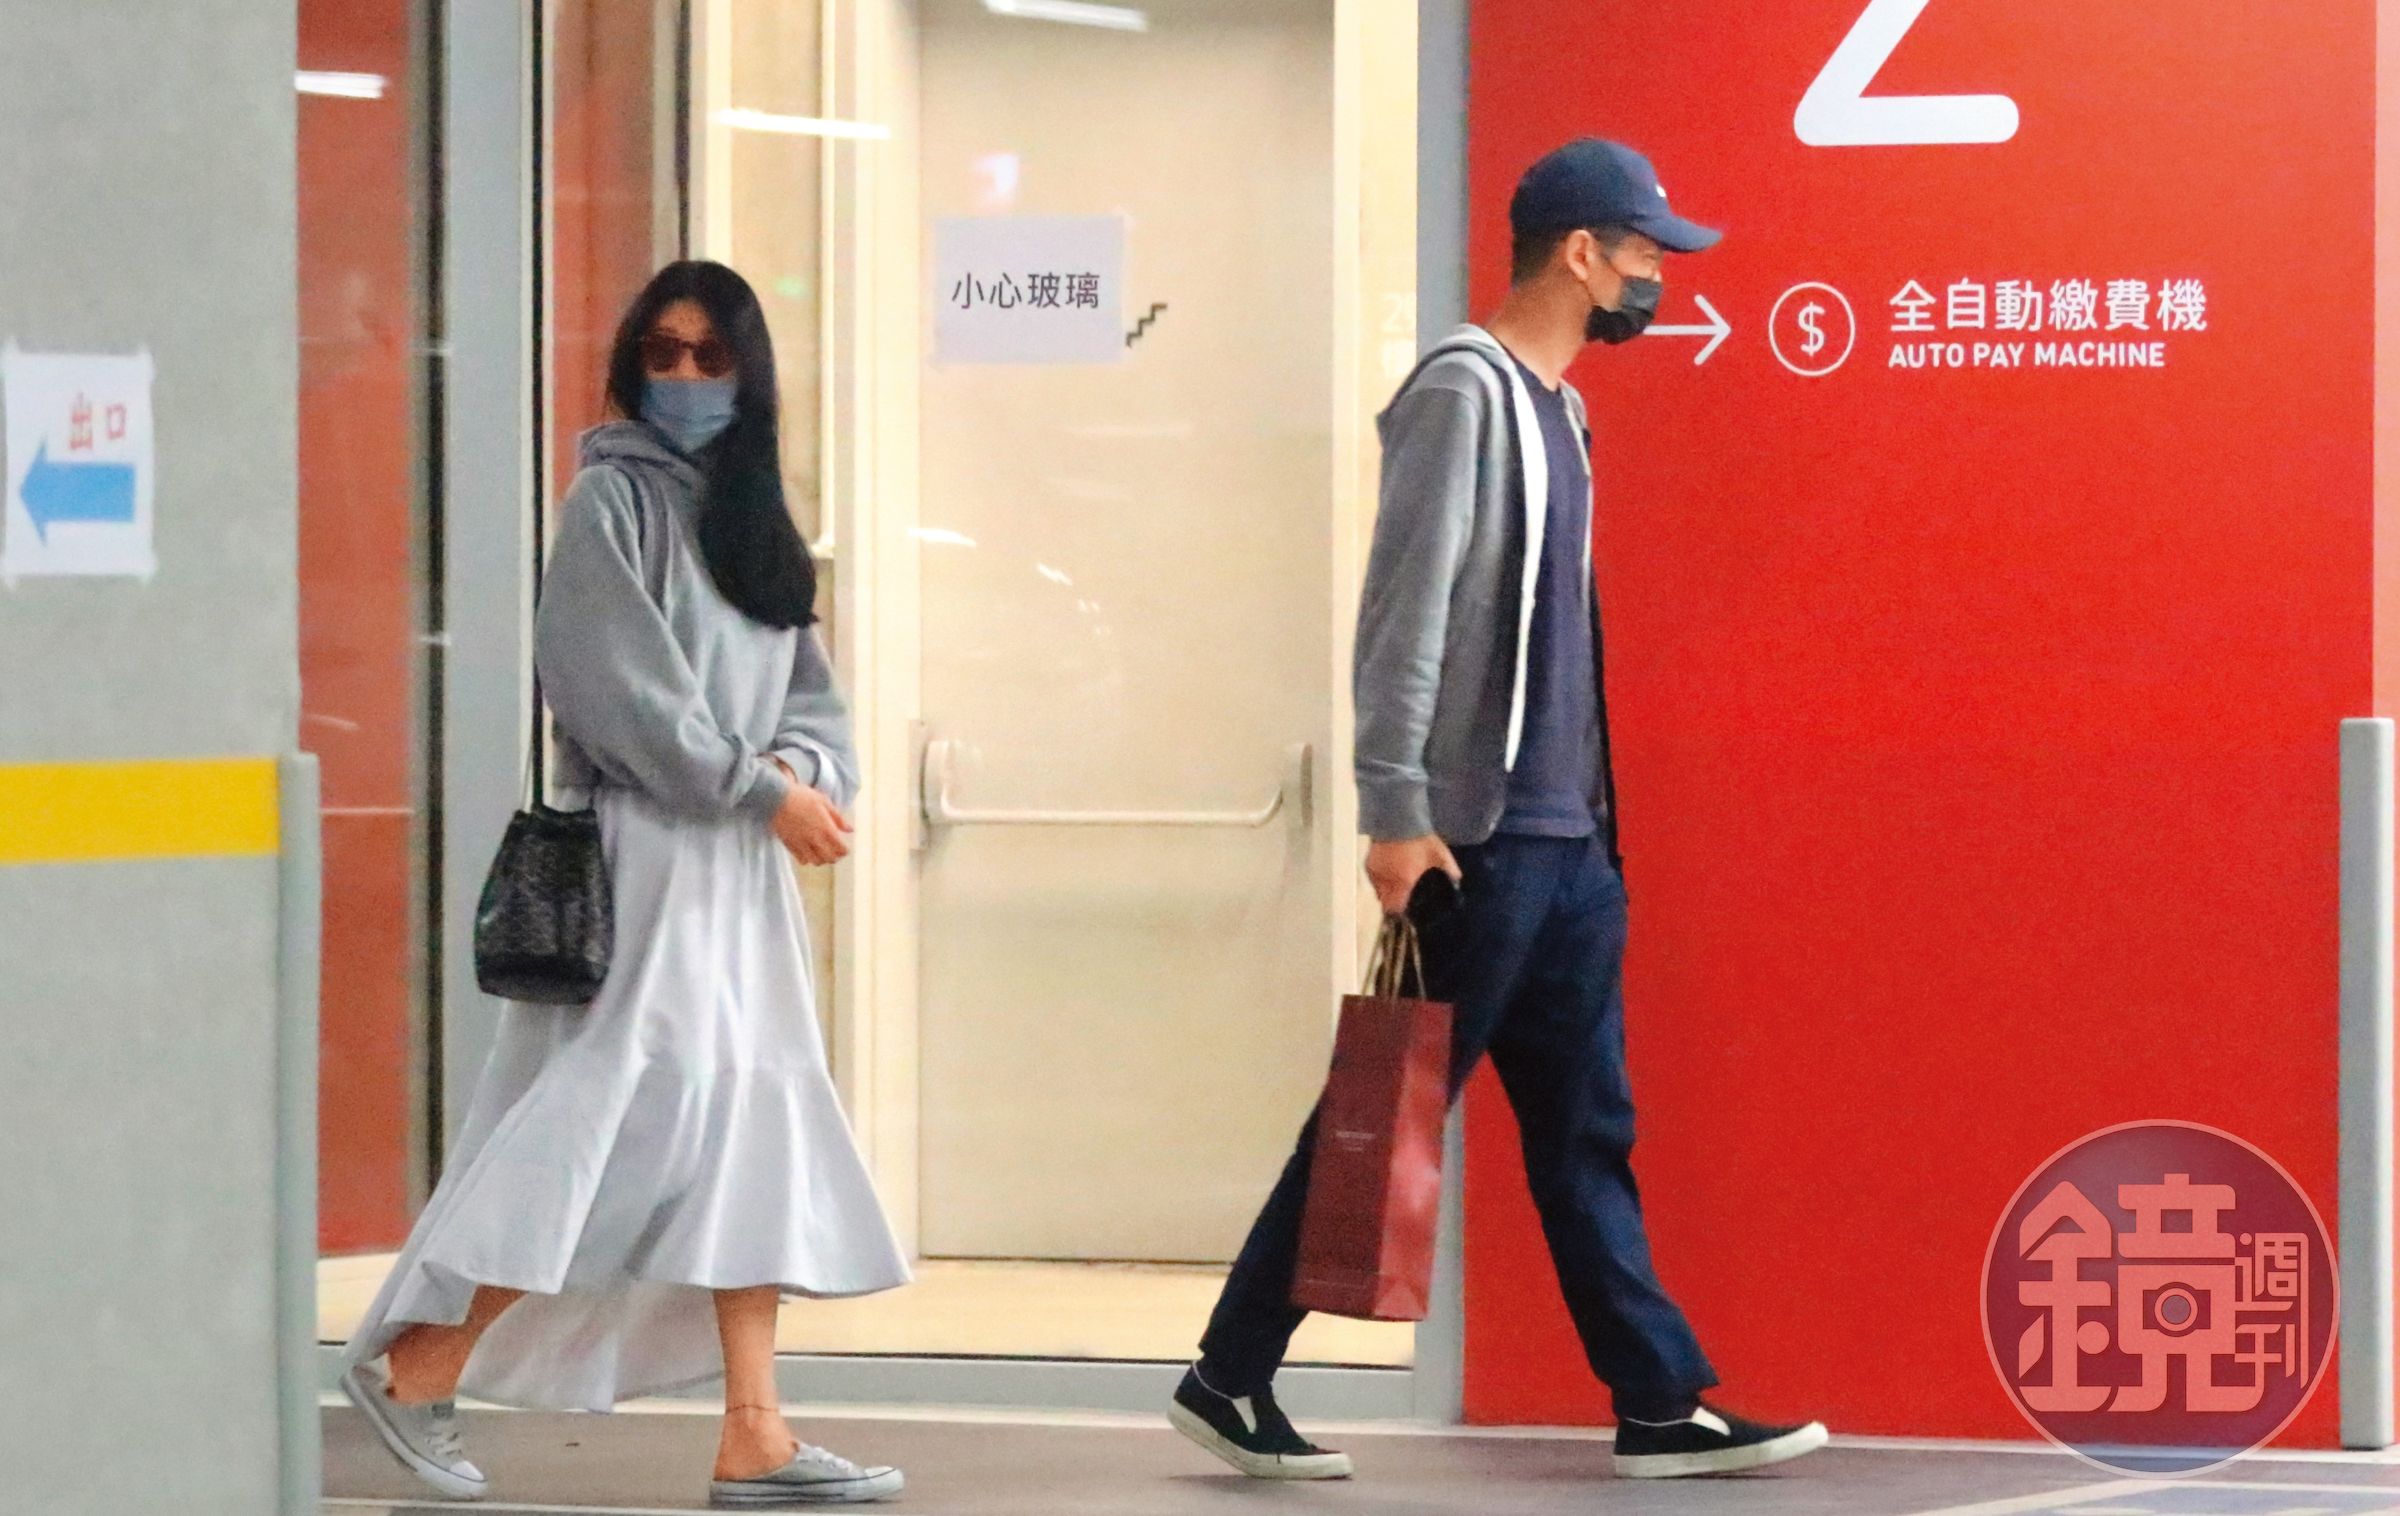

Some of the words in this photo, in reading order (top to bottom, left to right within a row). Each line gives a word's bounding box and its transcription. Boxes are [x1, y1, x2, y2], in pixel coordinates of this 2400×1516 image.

[951, 271, 1100, 310] 小心玻璃
[1889, 277, 2208, 332] 全自動繳費機
[1888, 342, 1965, 368] AUTO
[1973, 342, 2026, 367] PAY
[2033, 341, 2165, 367] MACHINE
[69, 392, 126, 450] 出口
